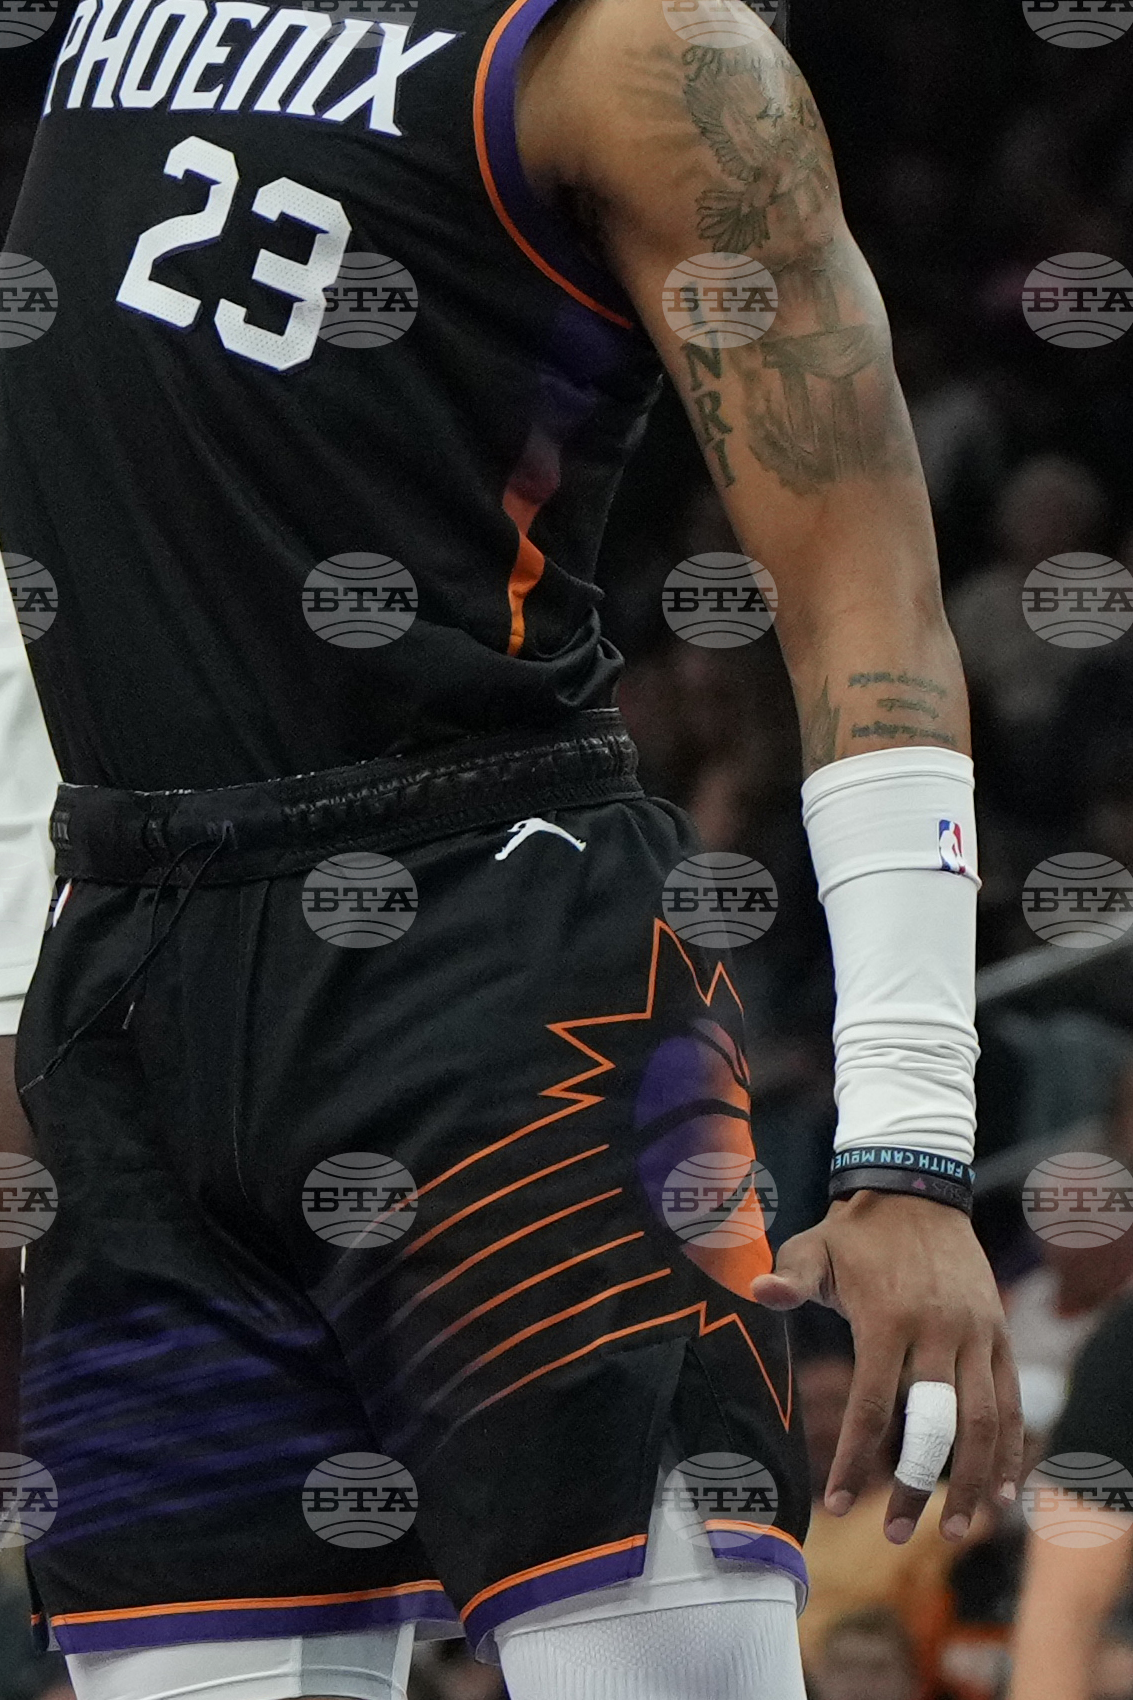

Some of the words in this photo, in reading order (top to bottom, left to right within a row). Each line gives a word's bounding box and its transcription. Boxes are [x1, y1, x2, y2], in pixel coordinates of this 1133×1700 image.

[115, 134, 353, 372] 23
[834, 1149, 876, 1169] MOVE
[881, 1149, 915, 1165] CAN
[919, 1157, 965, 1179] FAITH
